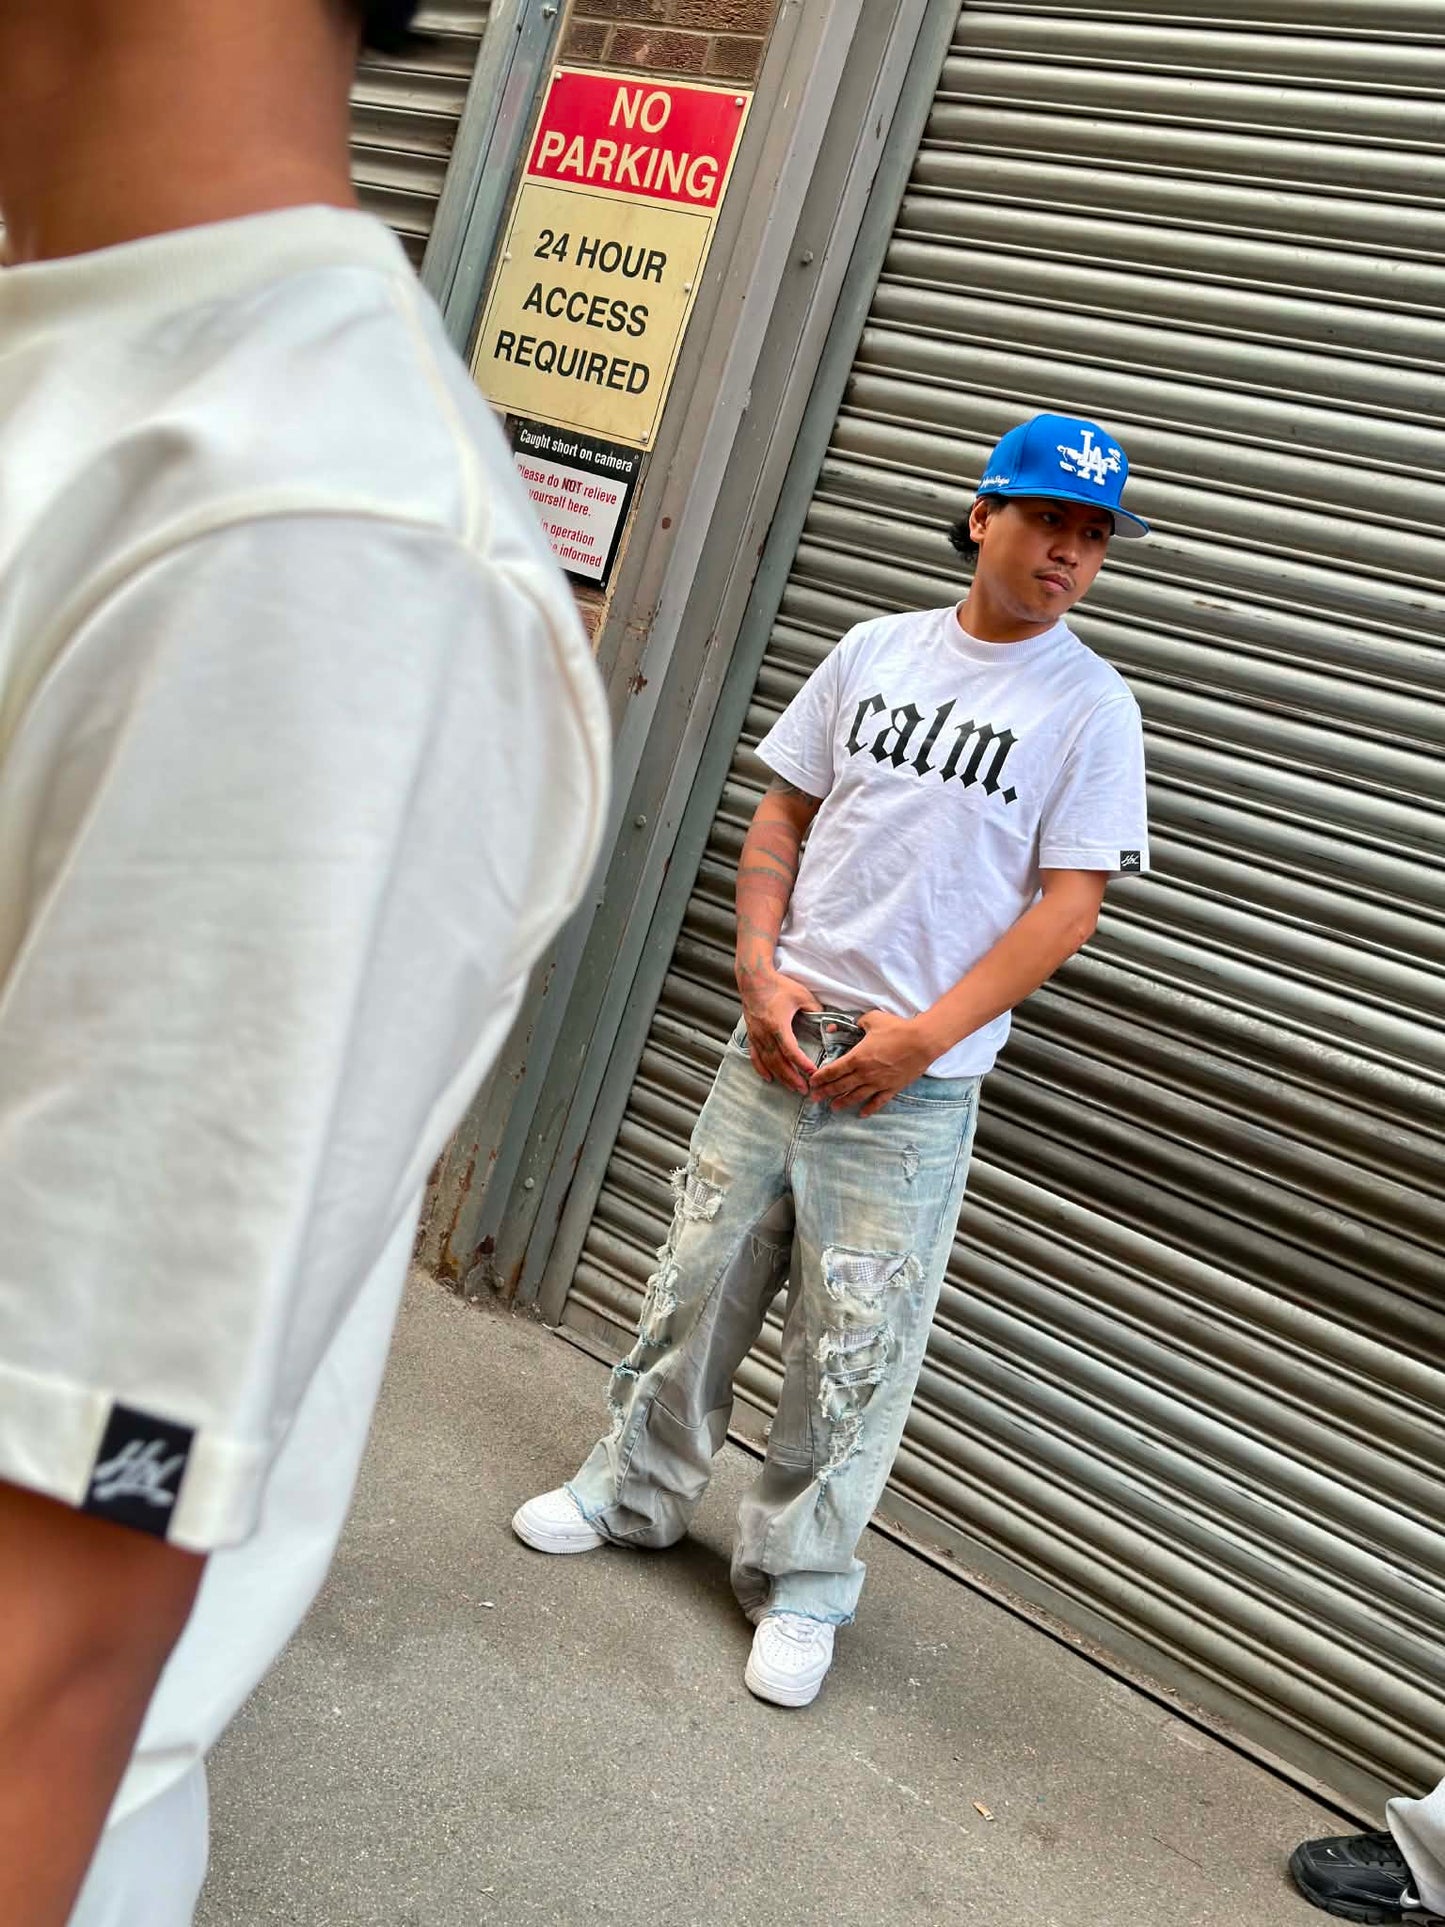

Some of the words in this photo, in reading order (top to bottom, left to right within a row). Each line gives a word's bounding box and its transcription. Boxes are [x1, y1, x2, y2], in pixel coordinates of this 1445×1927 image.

[609, 87, 671, 133] NO
[536, 130, 718, 200] PARKING
[533, 229, 571, 262] 24
[575, 236, 667, 283] HOUR
[522, 283, 649, 337] ACCESS
[494, 330, 650, 395] REQUIRED
[519, 429, 551, 449] Caught
[551, 439, 578, 458] short
[579, 448, 592, 460] on
[594, 452, 633, 472] camera
[547, 474, 559, 488] do
[561, 477, 583, 493] NOT
[583, 485, 617, 505] relieve
[567, 498, 591, 517] here.
[550, 524, 595, 547] operation
[559, 544, 602, 567] informed
[844, 693, 1019, 805] calm.
